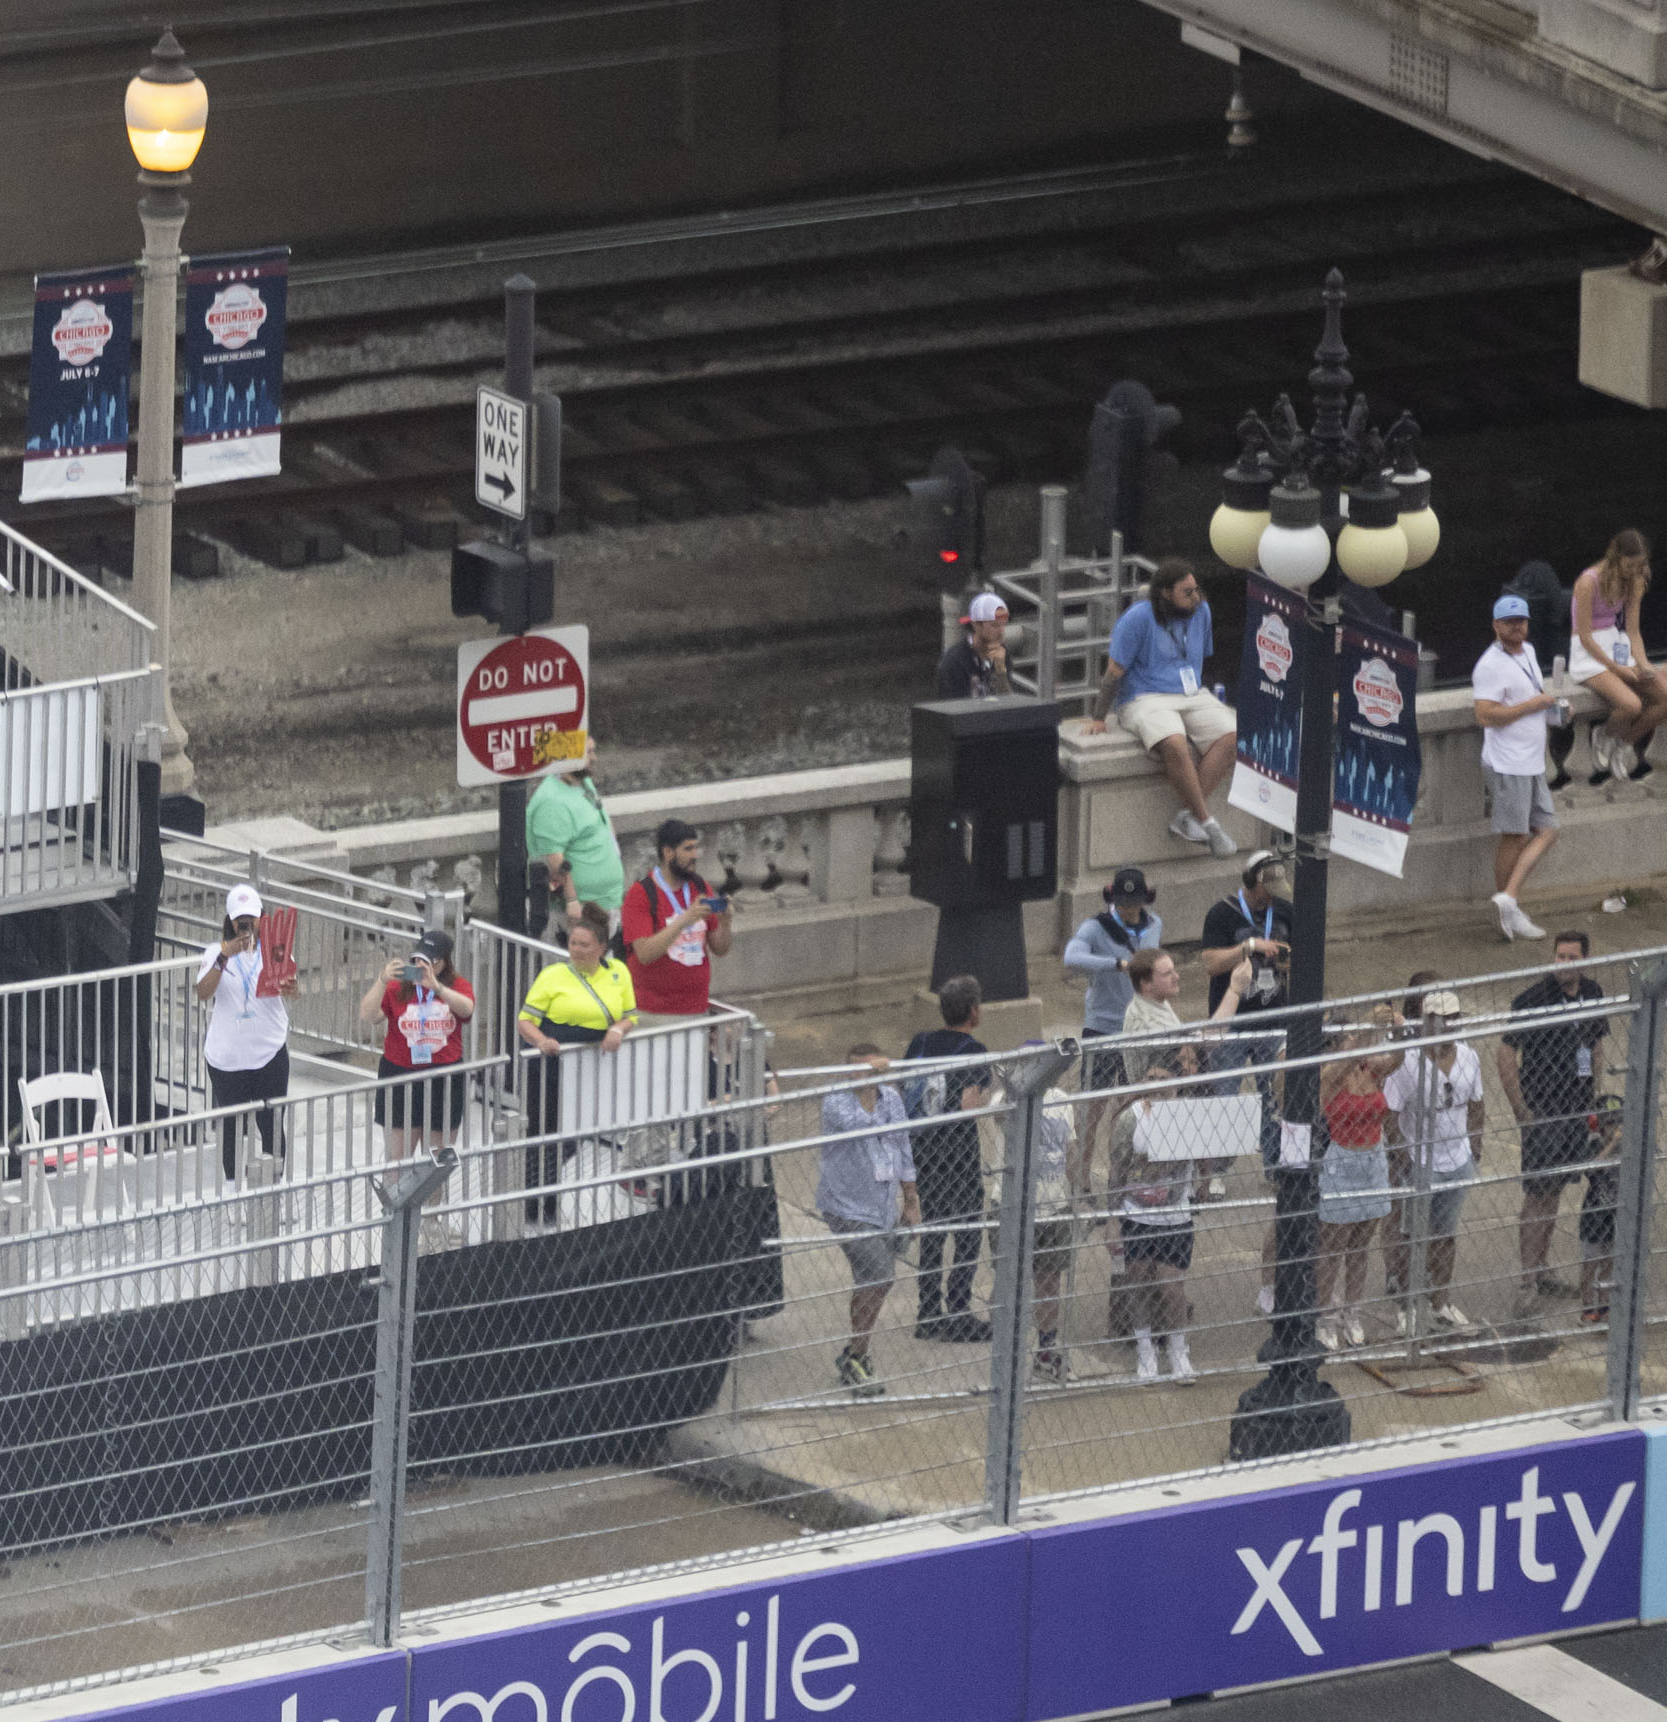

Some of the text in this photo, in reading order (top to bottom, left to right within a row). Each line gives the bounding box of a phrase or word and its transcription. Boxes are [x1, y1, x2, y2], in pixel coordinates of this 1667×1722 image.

[213, 311, 260, 325] CHICAGO
[59, 326, 107, 340] CHICAGO
[60, 368, 83, 381] JULY
[484, 402, 519, 438] ONE
[484, 431, 520, 468] WAY
[479, 658, 567, 691] DO NOT
[1358, 682, 1401, 703] CHICAGO
[1231, 1467, 1636, 1656] xfinity
